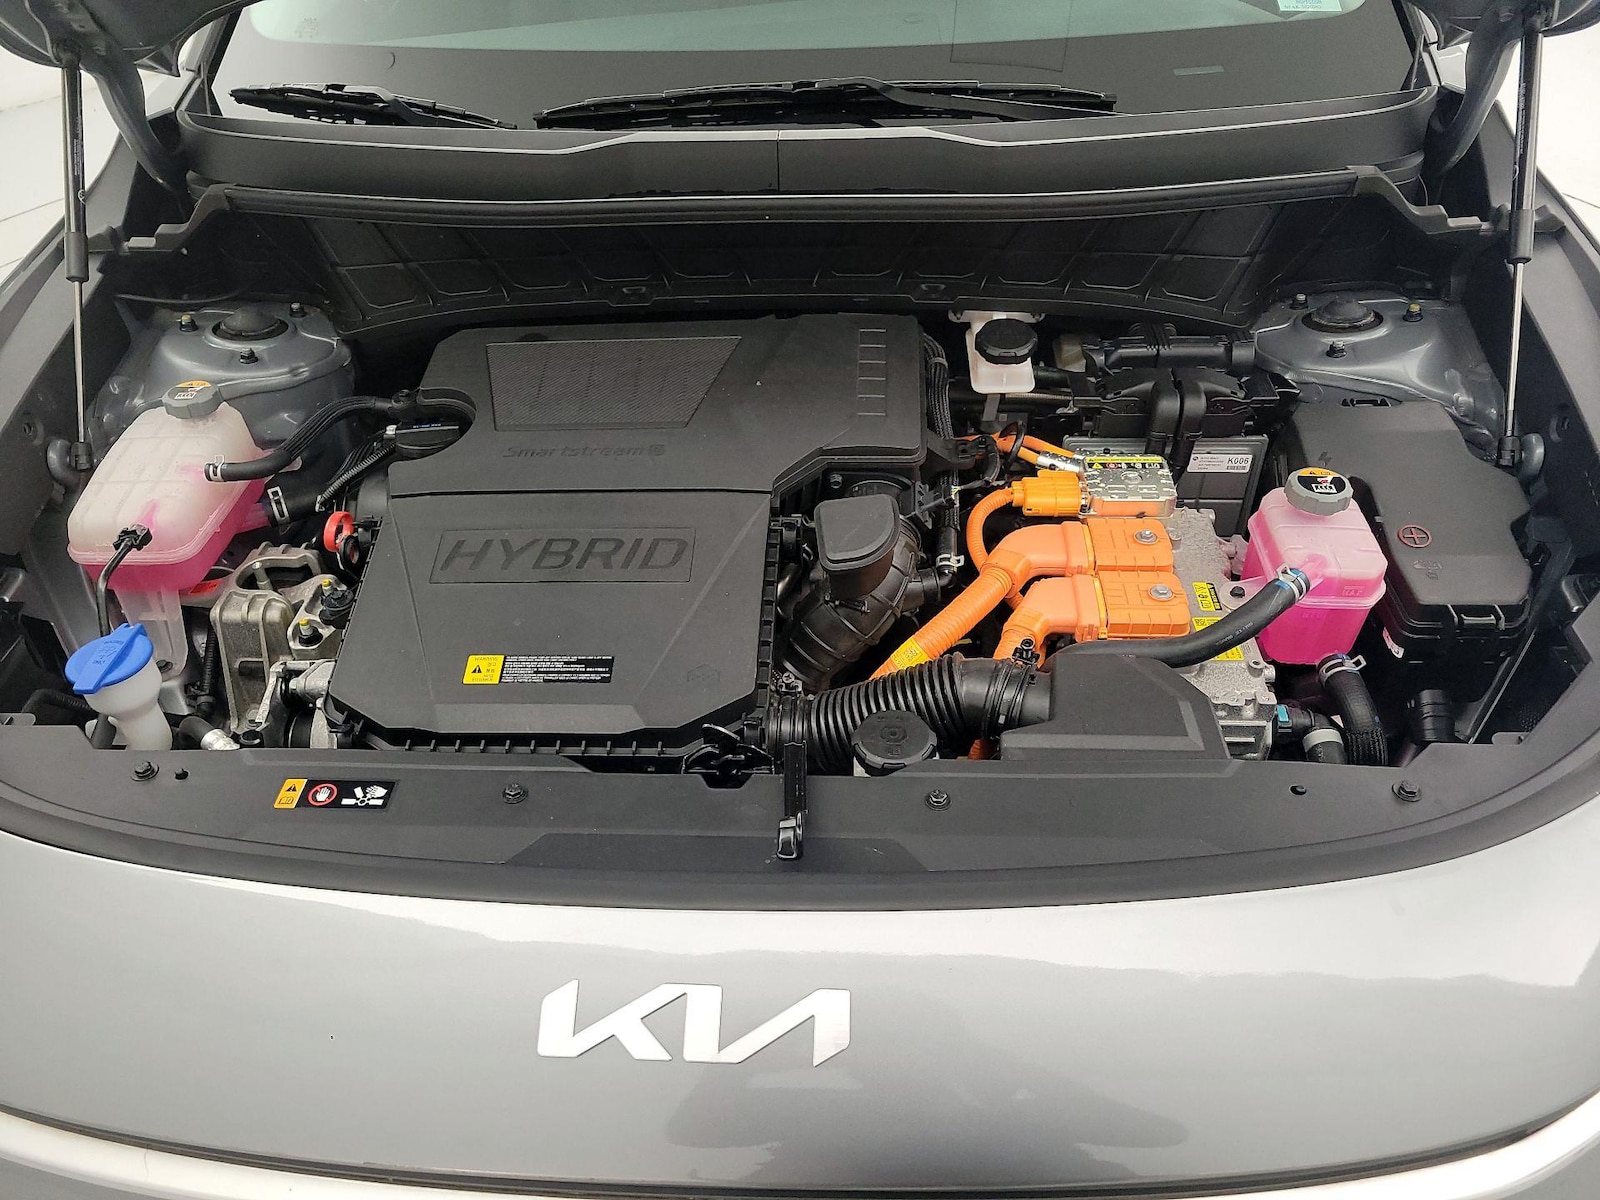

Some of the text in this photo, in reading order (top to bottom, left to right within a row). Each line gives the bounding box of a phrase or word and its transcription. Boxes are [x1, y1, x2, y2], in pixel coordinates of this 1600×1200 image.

[502, 445, 643, 458] Smartstream
[440, 537, 689, 571] HYBRID
[537, 978, 851, 1068] KIA
